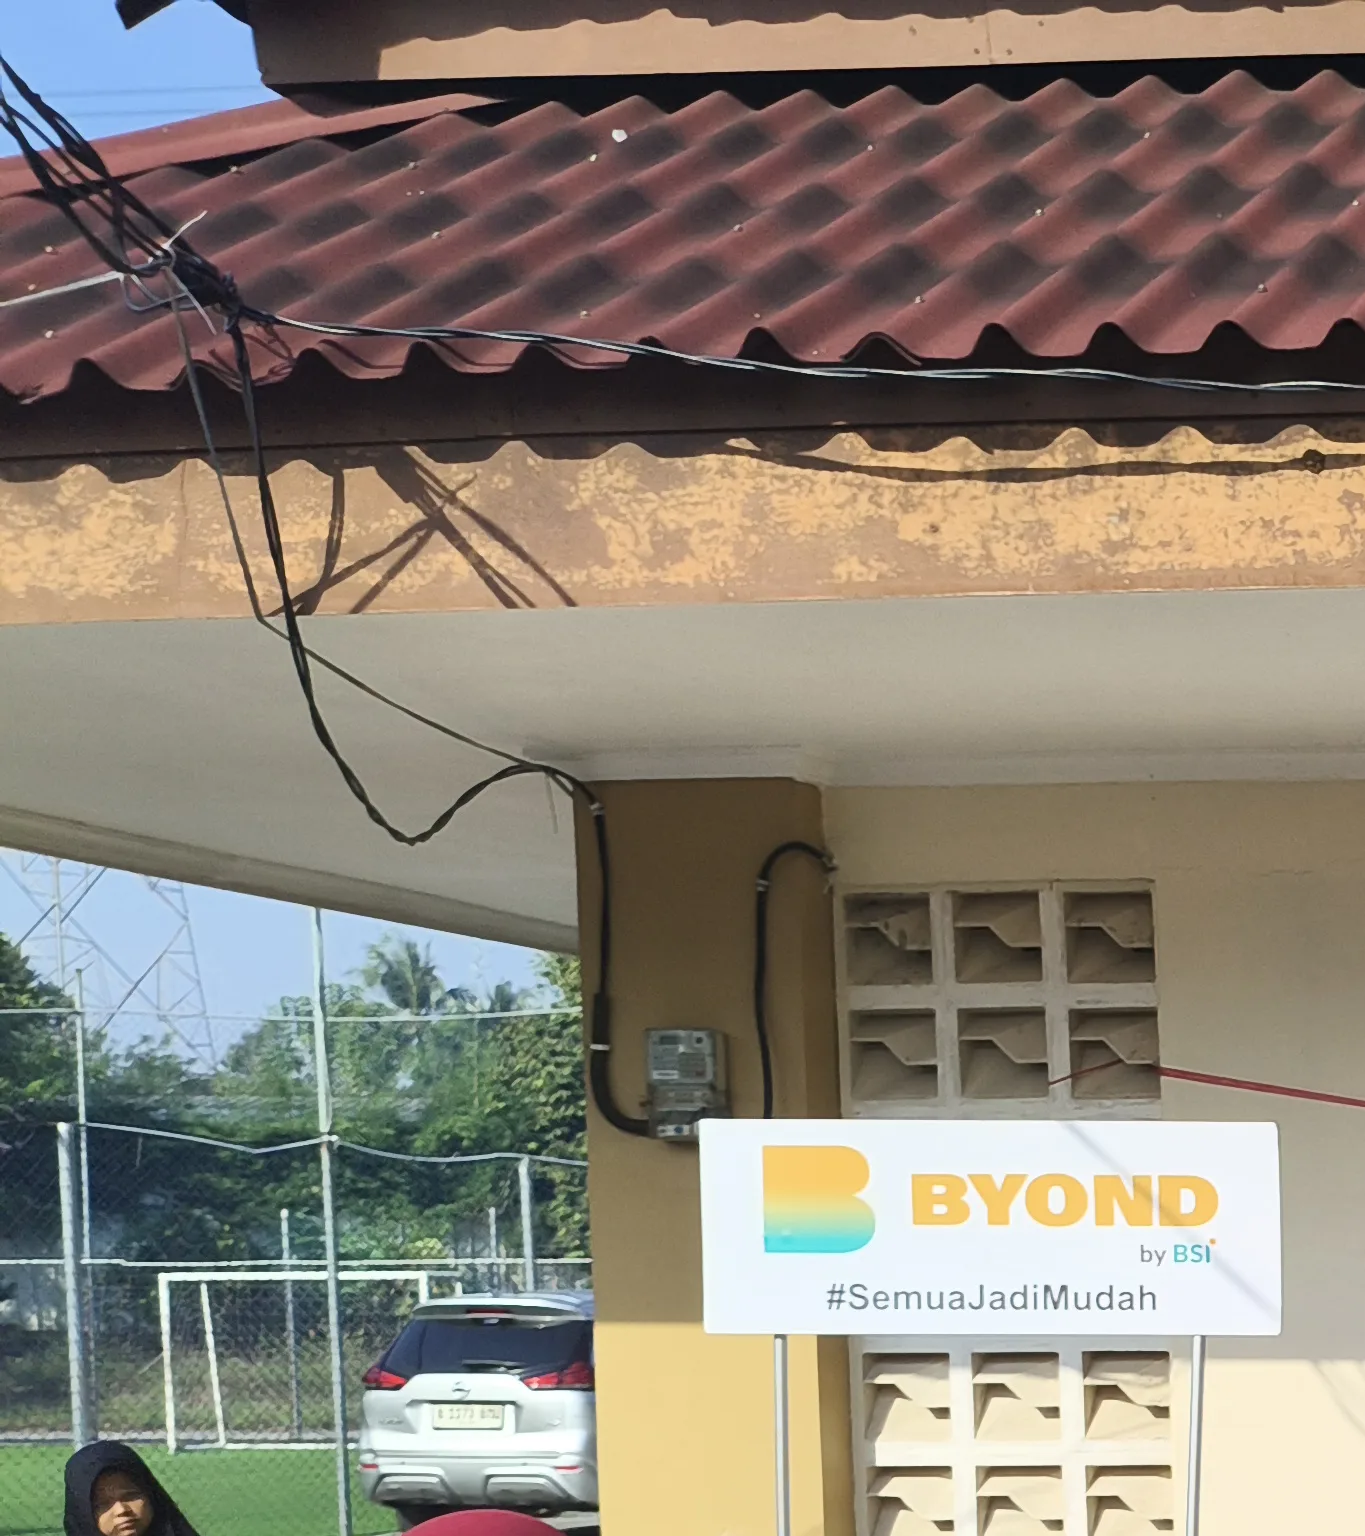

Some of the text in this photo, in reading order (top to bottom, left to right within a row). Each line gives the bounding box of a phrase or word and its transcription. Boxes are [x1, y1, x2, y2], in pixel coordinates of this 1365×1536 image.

[910, 1173, 1219, 1227] BYOND
[1140, 1238, 1216, 1267] by BSI
[826, 1283, 1158, 1311] #SemuaJadiMudah
